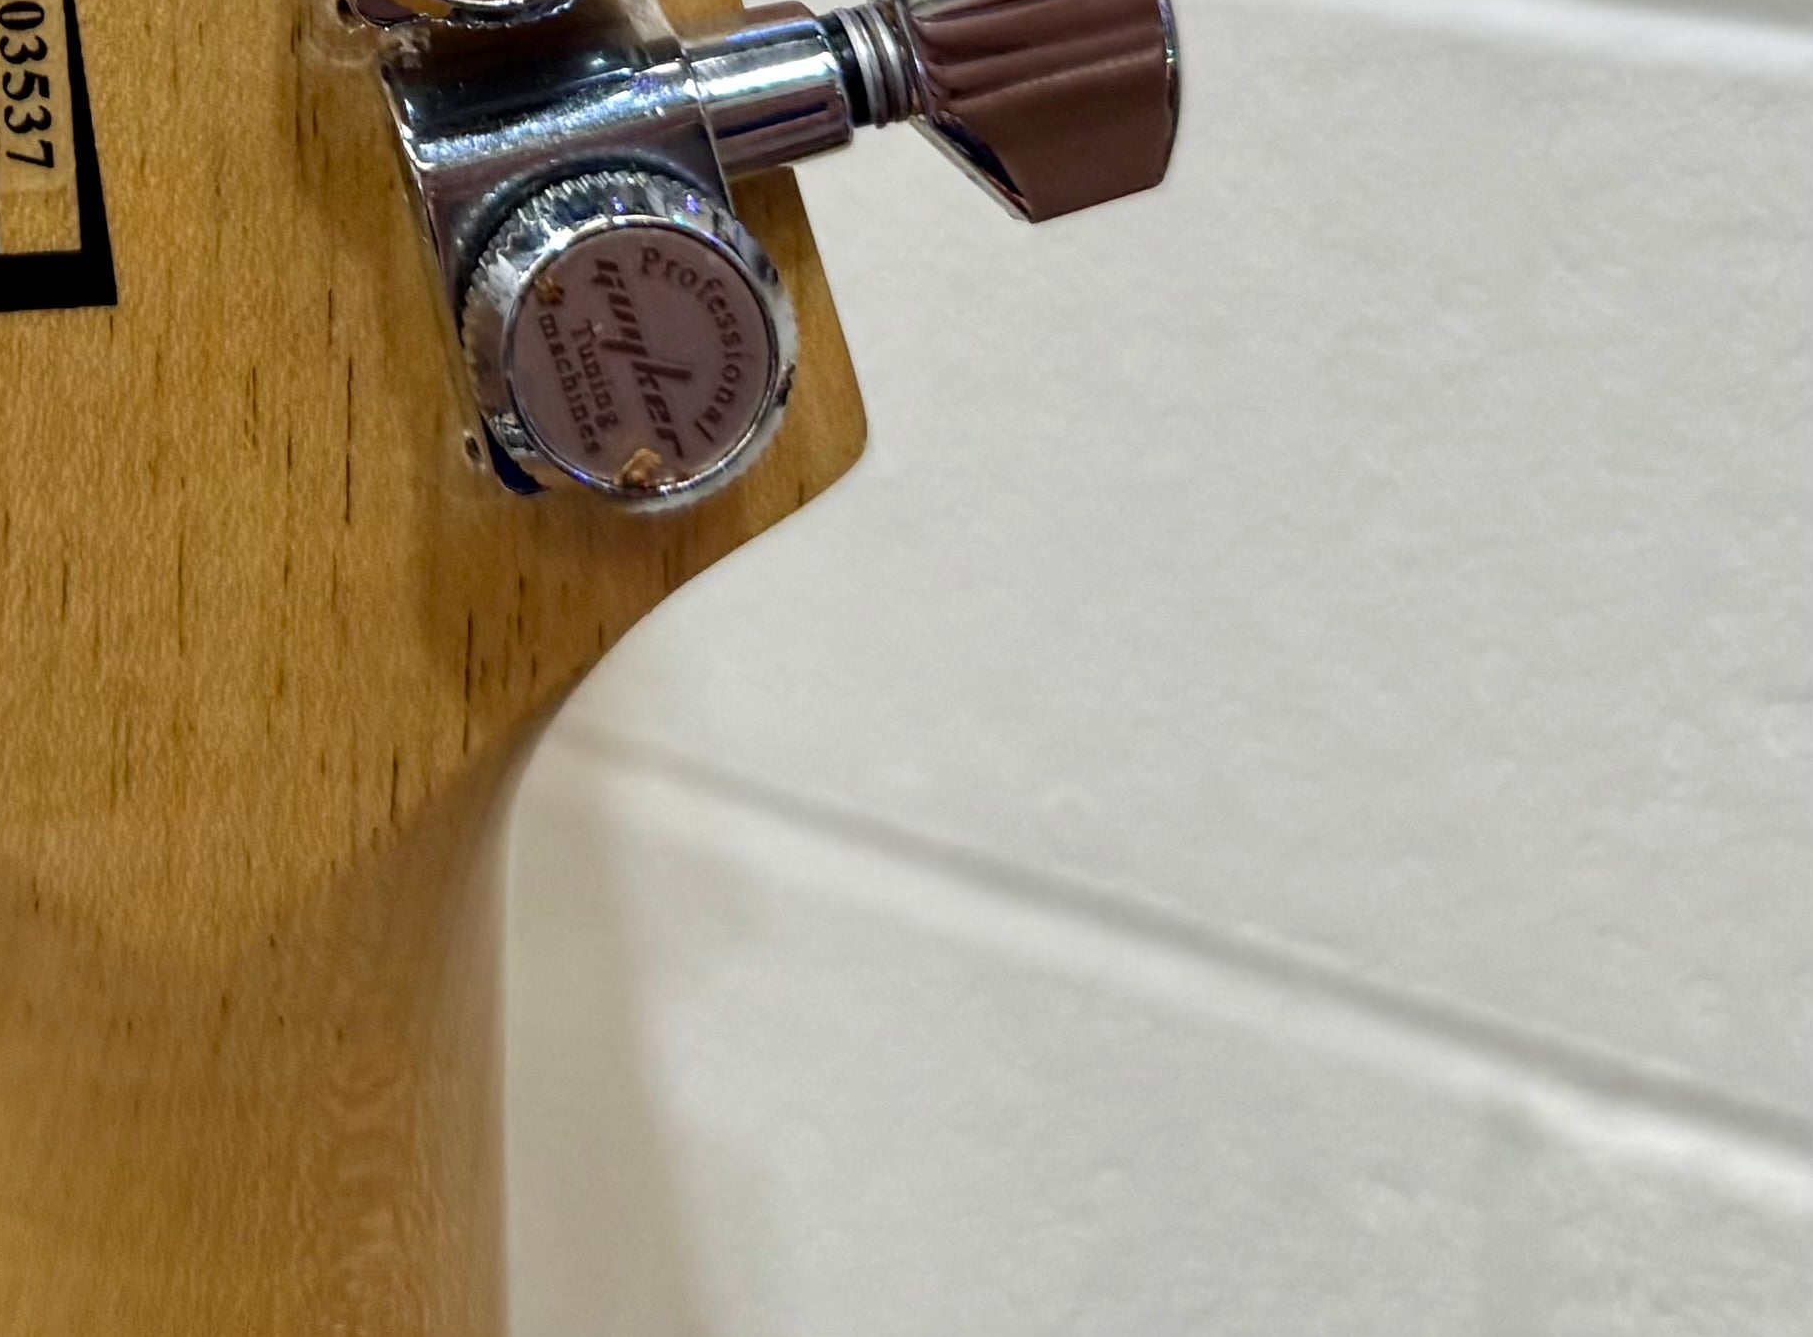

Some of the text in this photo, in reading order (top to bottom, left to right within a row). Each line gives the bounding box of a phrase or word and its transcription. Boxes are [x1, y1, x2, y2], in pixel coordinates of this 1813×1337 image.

[539, 313, 600, 454] machines
[572, 319, 619, 429] Tuning
[640, 247, 742, 443] Professional
